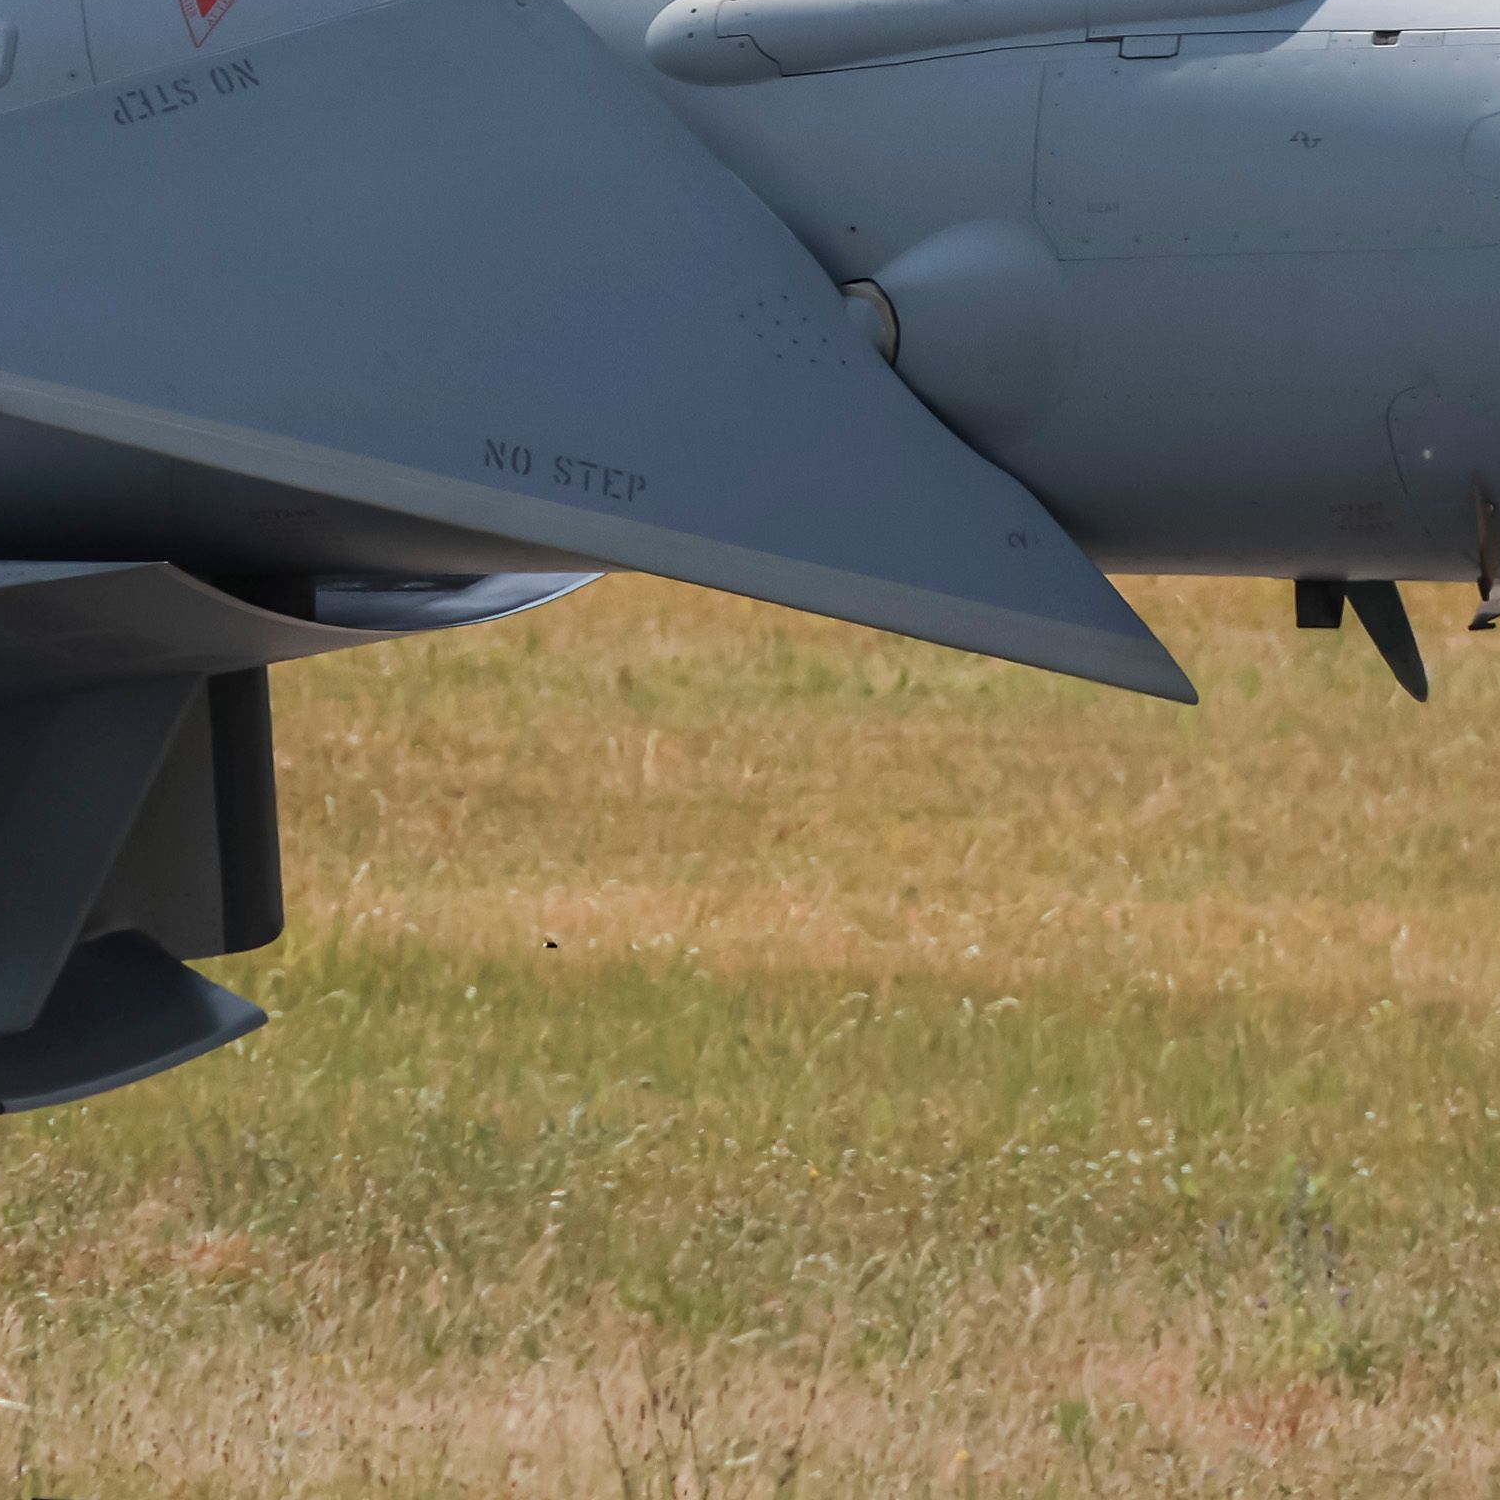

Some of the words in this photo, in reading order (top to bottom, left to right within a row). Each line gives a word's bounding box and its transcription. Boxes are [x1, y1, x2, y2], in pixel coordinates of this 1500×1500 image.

[210, 58, 260, 94] NO
[114, 77, 198, 125] STEP
[484, 438, 532, 476] NO
[553, 455, 647, 503] STEP
